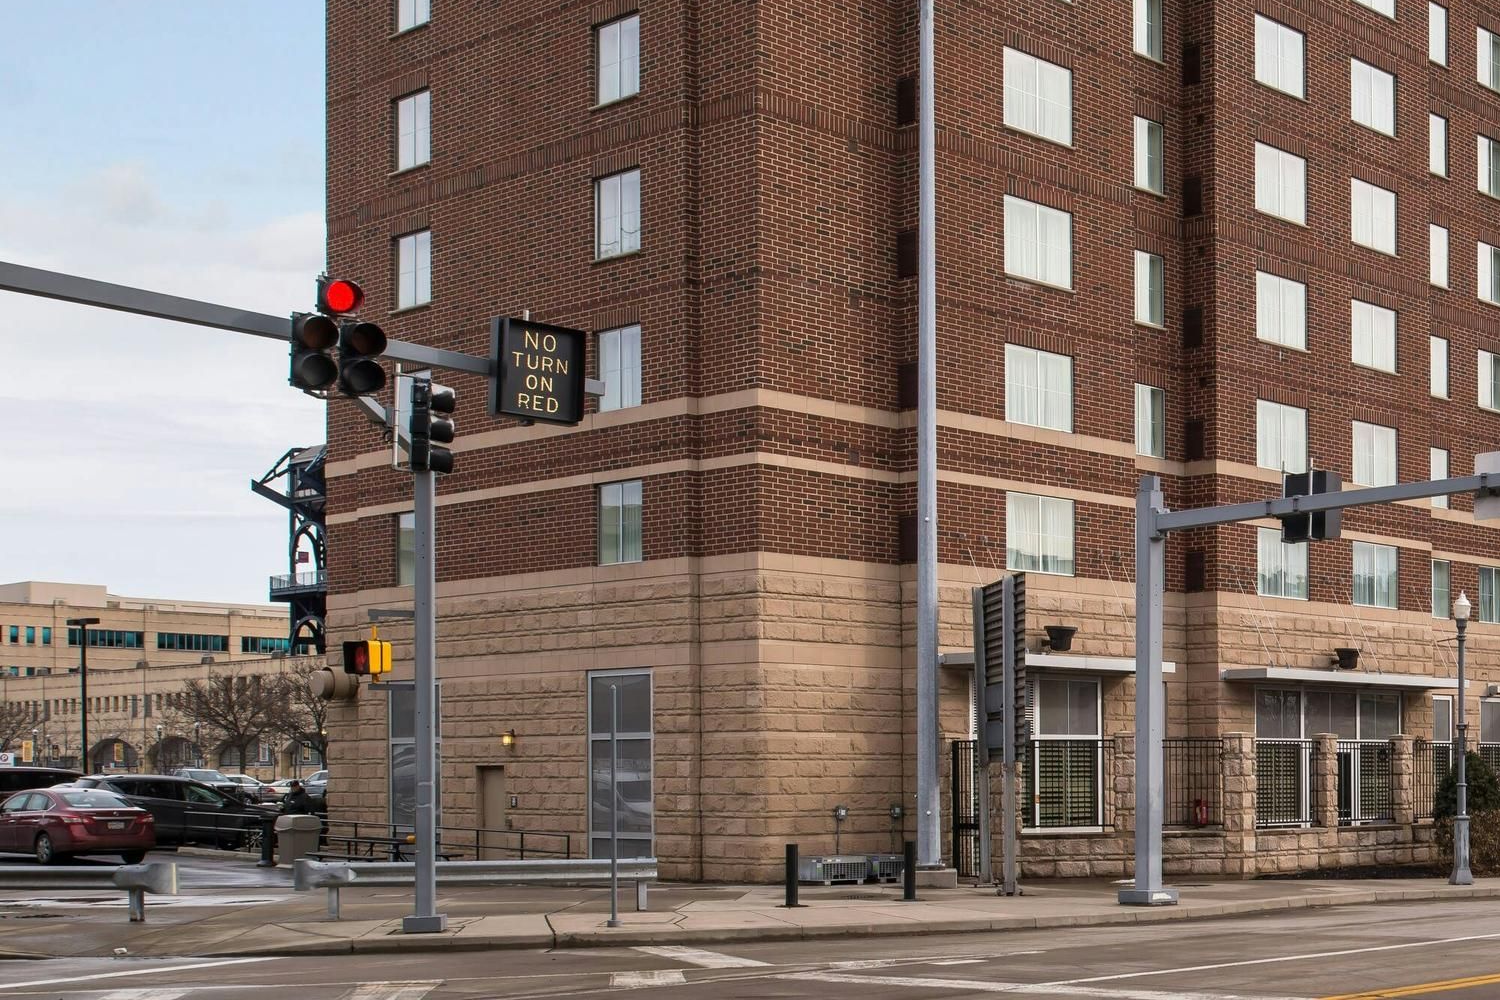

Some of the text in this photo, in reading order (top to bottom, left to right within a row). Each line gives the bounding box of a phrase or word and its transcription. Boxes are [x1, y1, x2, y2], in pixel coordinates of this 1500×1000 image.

[525, 330, 557, 352] NO
[512, 351, 568, 375] TURN
[526, 374, 553, 392] ON
[518, 392, 559, 413] RED
